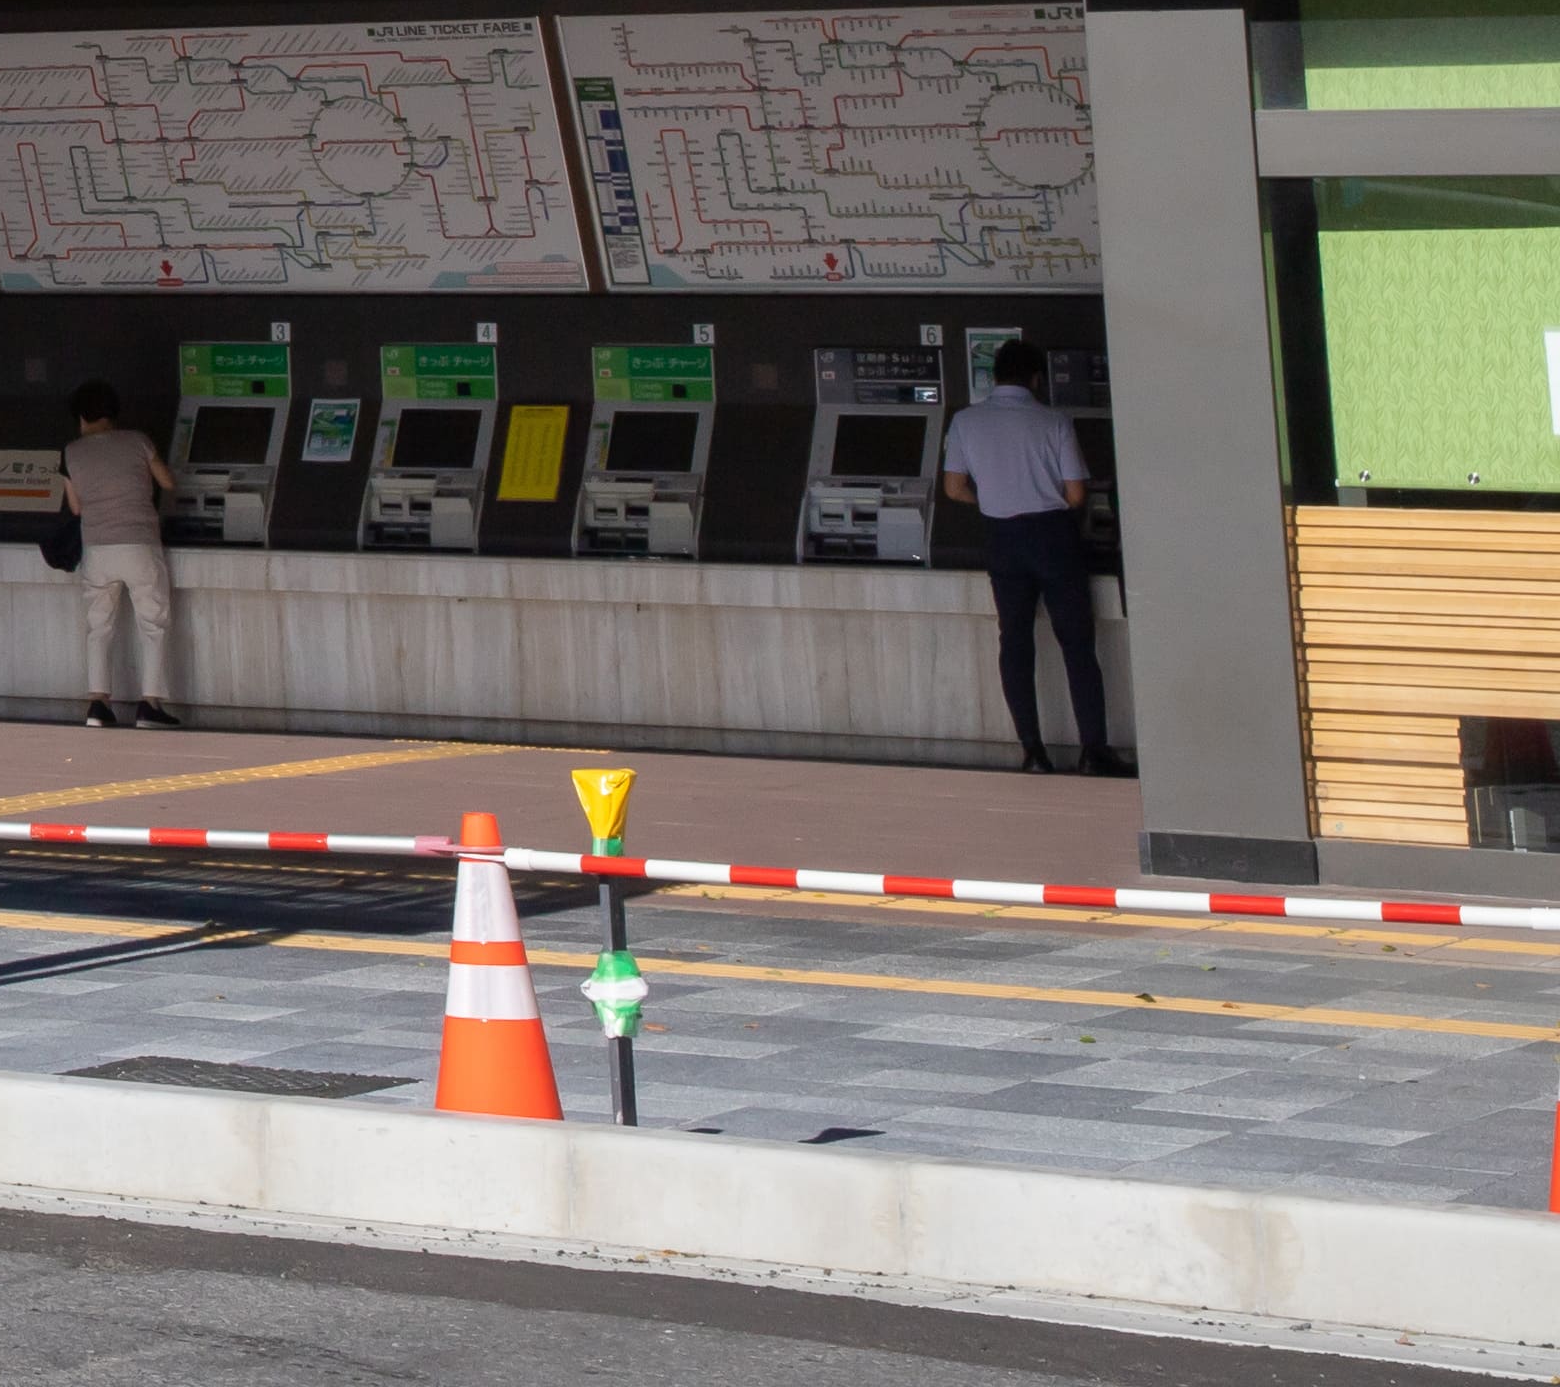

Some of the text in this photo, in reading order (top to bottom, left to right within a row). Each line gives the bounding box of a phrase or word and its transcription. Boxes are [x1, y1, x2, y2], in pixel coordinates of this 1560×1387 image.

[431, 23, 480, 35] TICKET
[483, 21, 521, 33] FARE
[275, 323, 286, 341] 3
[481, 324, 491, 340] 4
[699, 325, 710, 343] 5
[926, 326, 937, 345] 6
